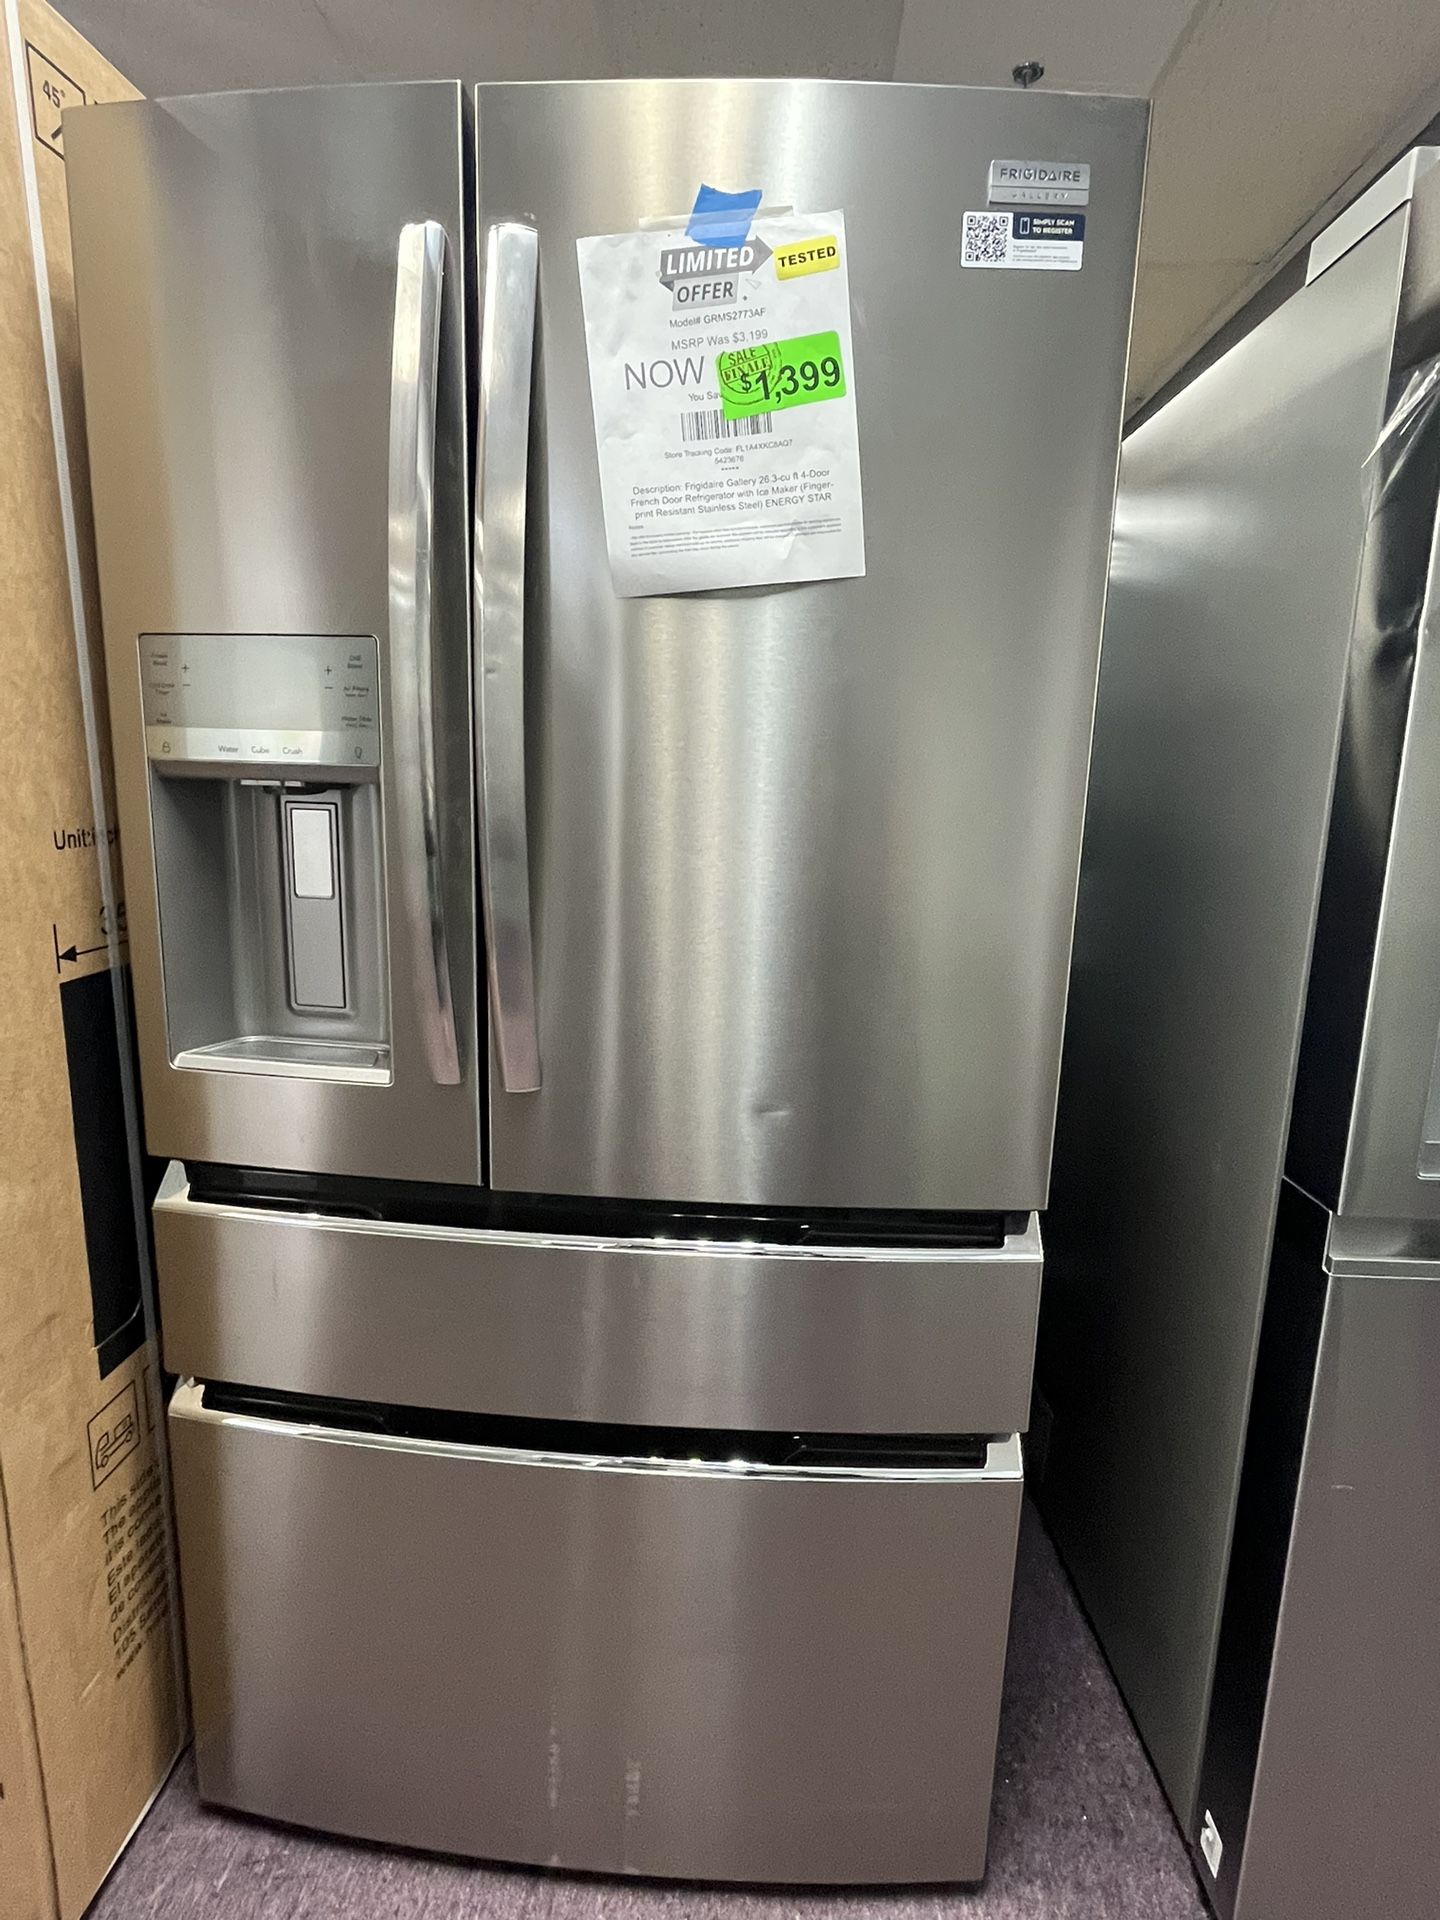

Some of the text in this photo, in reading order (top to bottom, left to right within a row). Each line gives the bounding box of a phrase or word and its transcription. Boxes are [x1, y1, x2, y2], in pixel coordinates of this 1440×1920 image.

[999, 167, 1081, 182] FRIGIDAIRE
[666, 245, 755, 275] LIMITED
[777, 245, 837, 268] TESTED
[676, 280, 734, 304] OFFER
[669, 307, 767, 329] Model# GRMS2773AF
[671, 337, 705, 351] MSRP
[706, 335, 730, 347] Was
[727, 347, 757, 366] SALE
[624, 355, 705, 390] NOW
[740, 356, 840, 404] $1,399
[687, 391, 724, 402] You Sav
[684, 480, 725, 492] Frigidaire
[726, 477, 757, 488] Gallery
[800, 468, 830, 479] 4-Door
[630, 480, 835, 508] French Door Refrigerator with Ice Maker (Finger-
[634, 491, 833, 521] print Resistant Stainless Steel) ENERGY STAR
